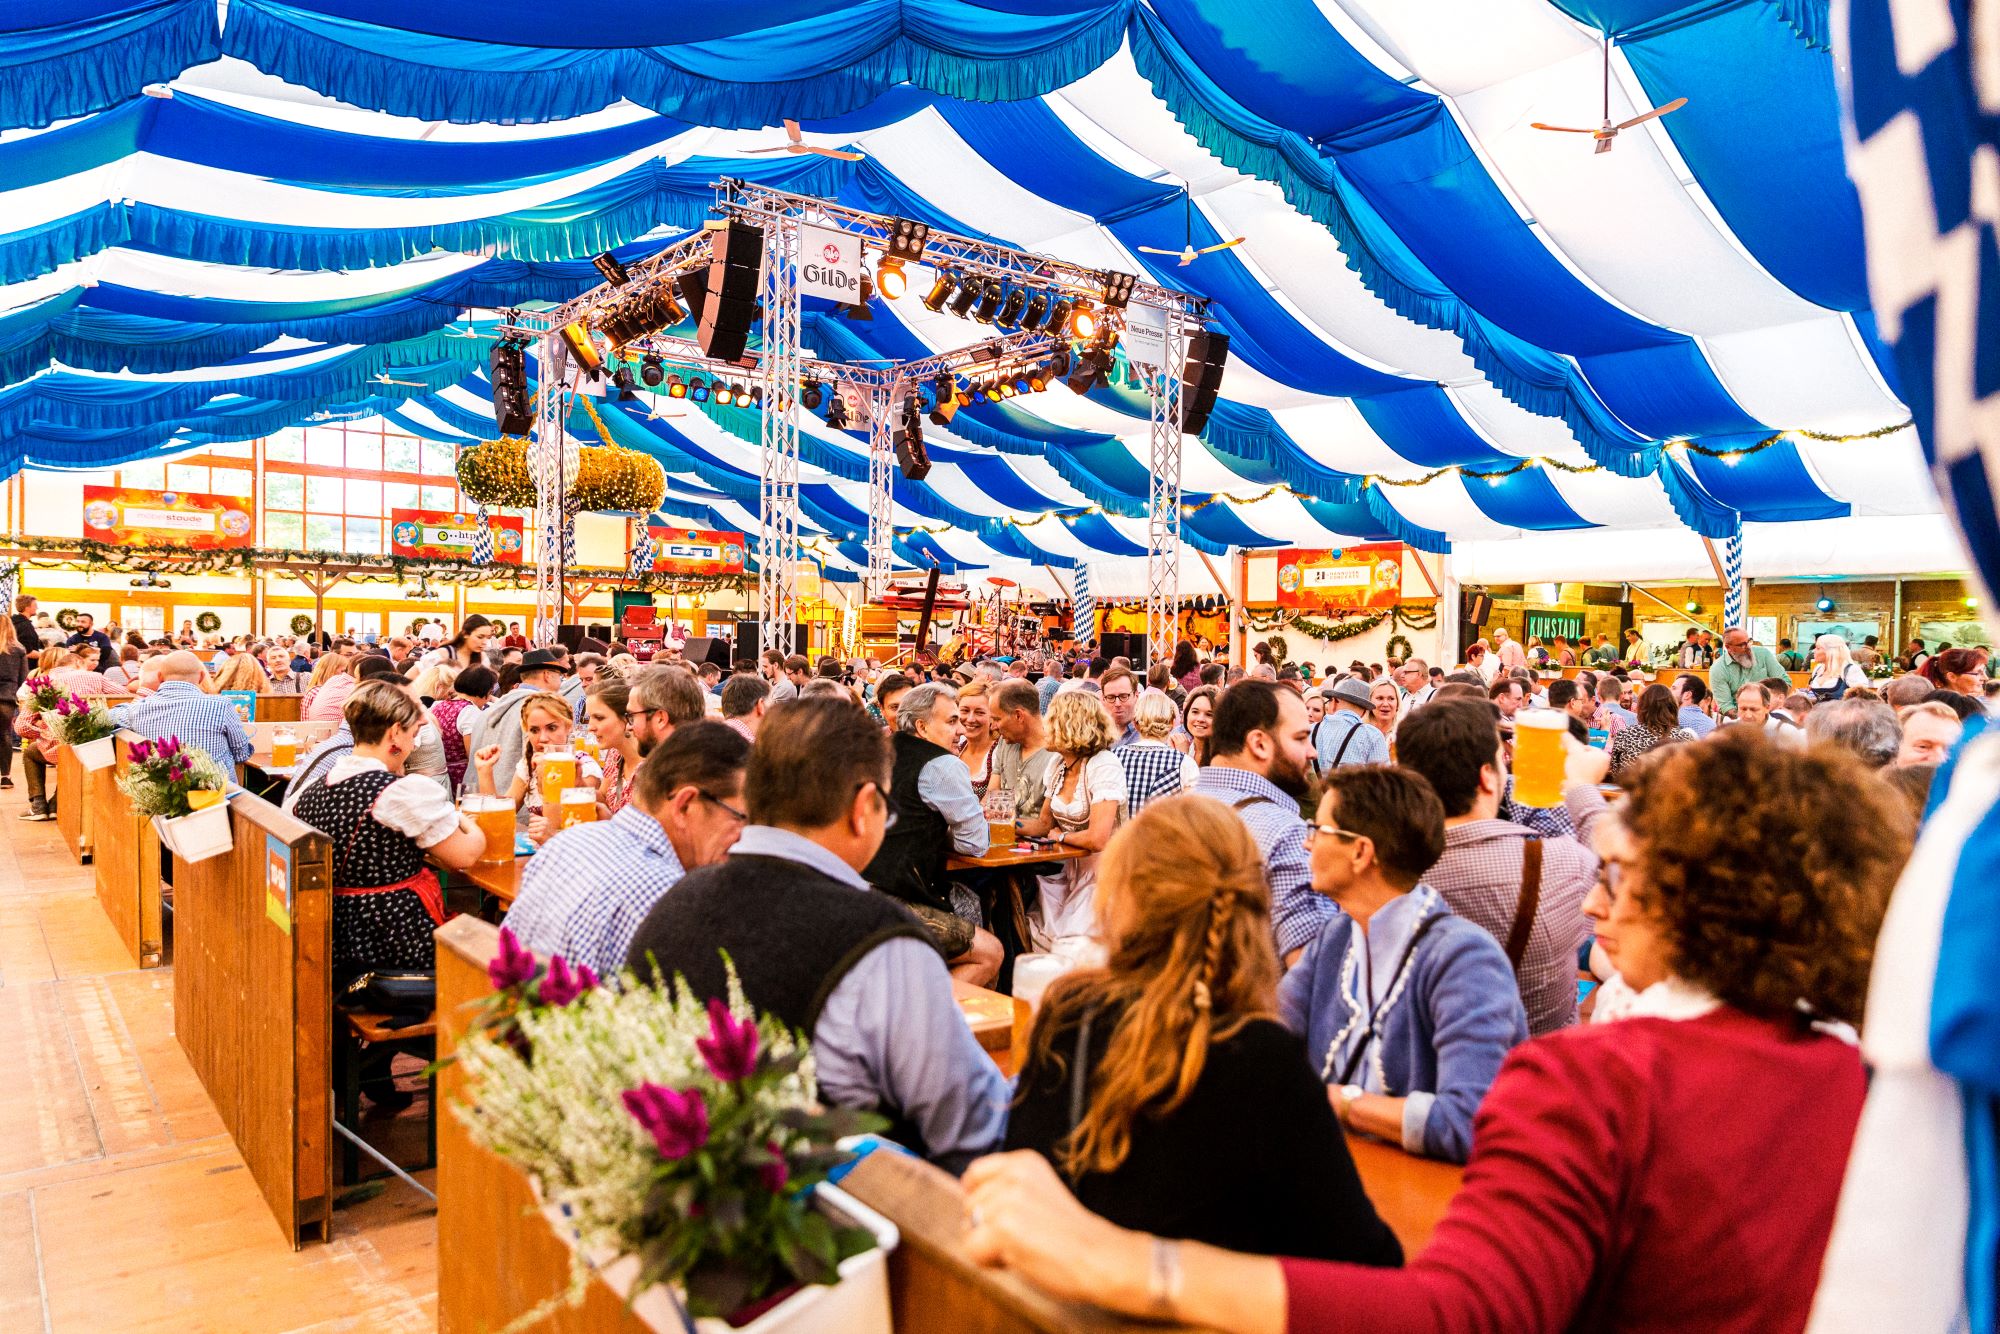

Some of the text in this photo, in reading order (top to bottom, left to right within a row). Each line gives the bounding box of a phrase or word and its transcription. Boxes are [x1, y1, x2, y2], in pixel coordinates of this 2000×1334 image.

[803, 264, 858, 291] Gilde
[1130, 324, 1163, 339] Neue Presse
[458, 530, 476, 540] htp
[1529, 616, 1581, 640] KUHSTADL
